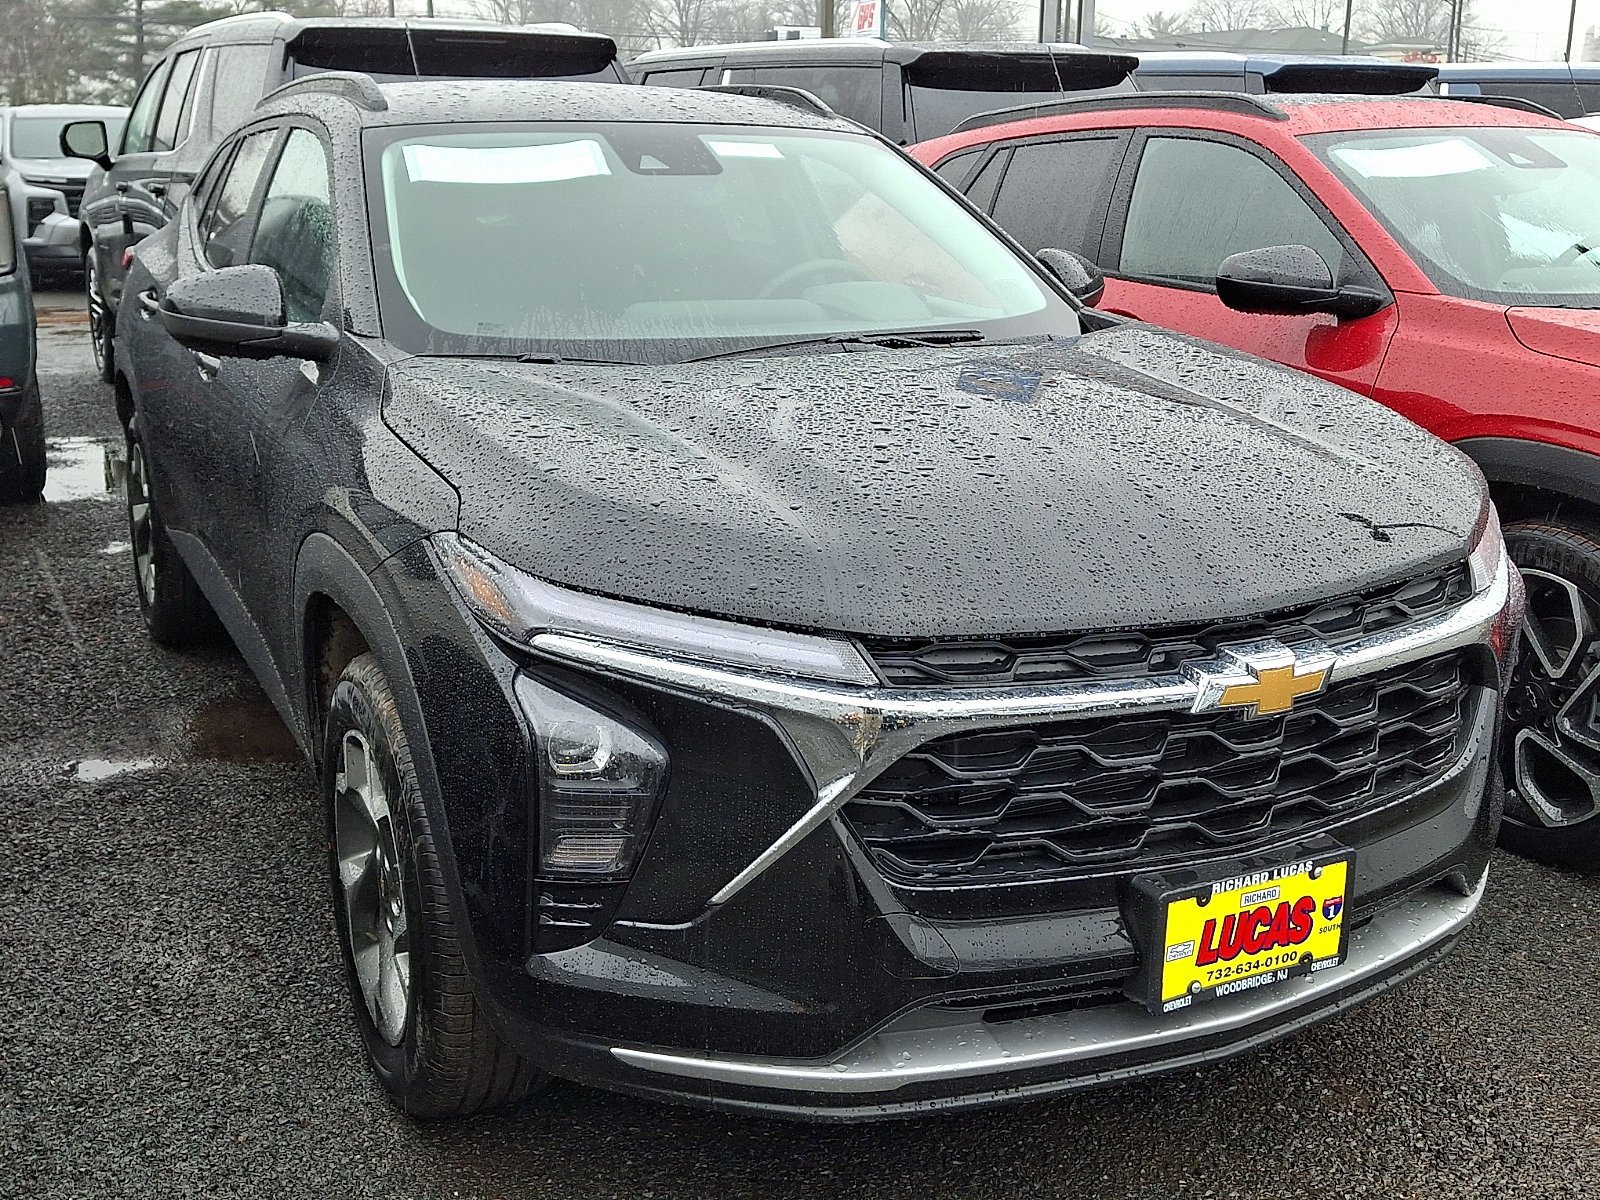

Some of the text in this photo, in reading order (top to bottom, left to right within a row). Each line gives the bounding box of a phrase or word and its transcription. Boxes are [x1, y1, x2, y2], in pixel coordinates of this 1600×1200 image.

[1212, 860, 1313, 895] RICHARD LUCAS
[1244, 889, 1278, 905] RICHARD
[1327, 904, 1336, 919] 1
[1195, 896, 1316, 967] LUCAS
[1319, 922, 1342, 934] SOUTH
[1207, 951, 1298, 982] 732-634-0100
[1311, 957, 1340, 972] CHEVROLET
[1215, 968, 1289, 998] WOODBRIDGE, NJ
[1163, 995, 1193, 1013] CHEVROLET
